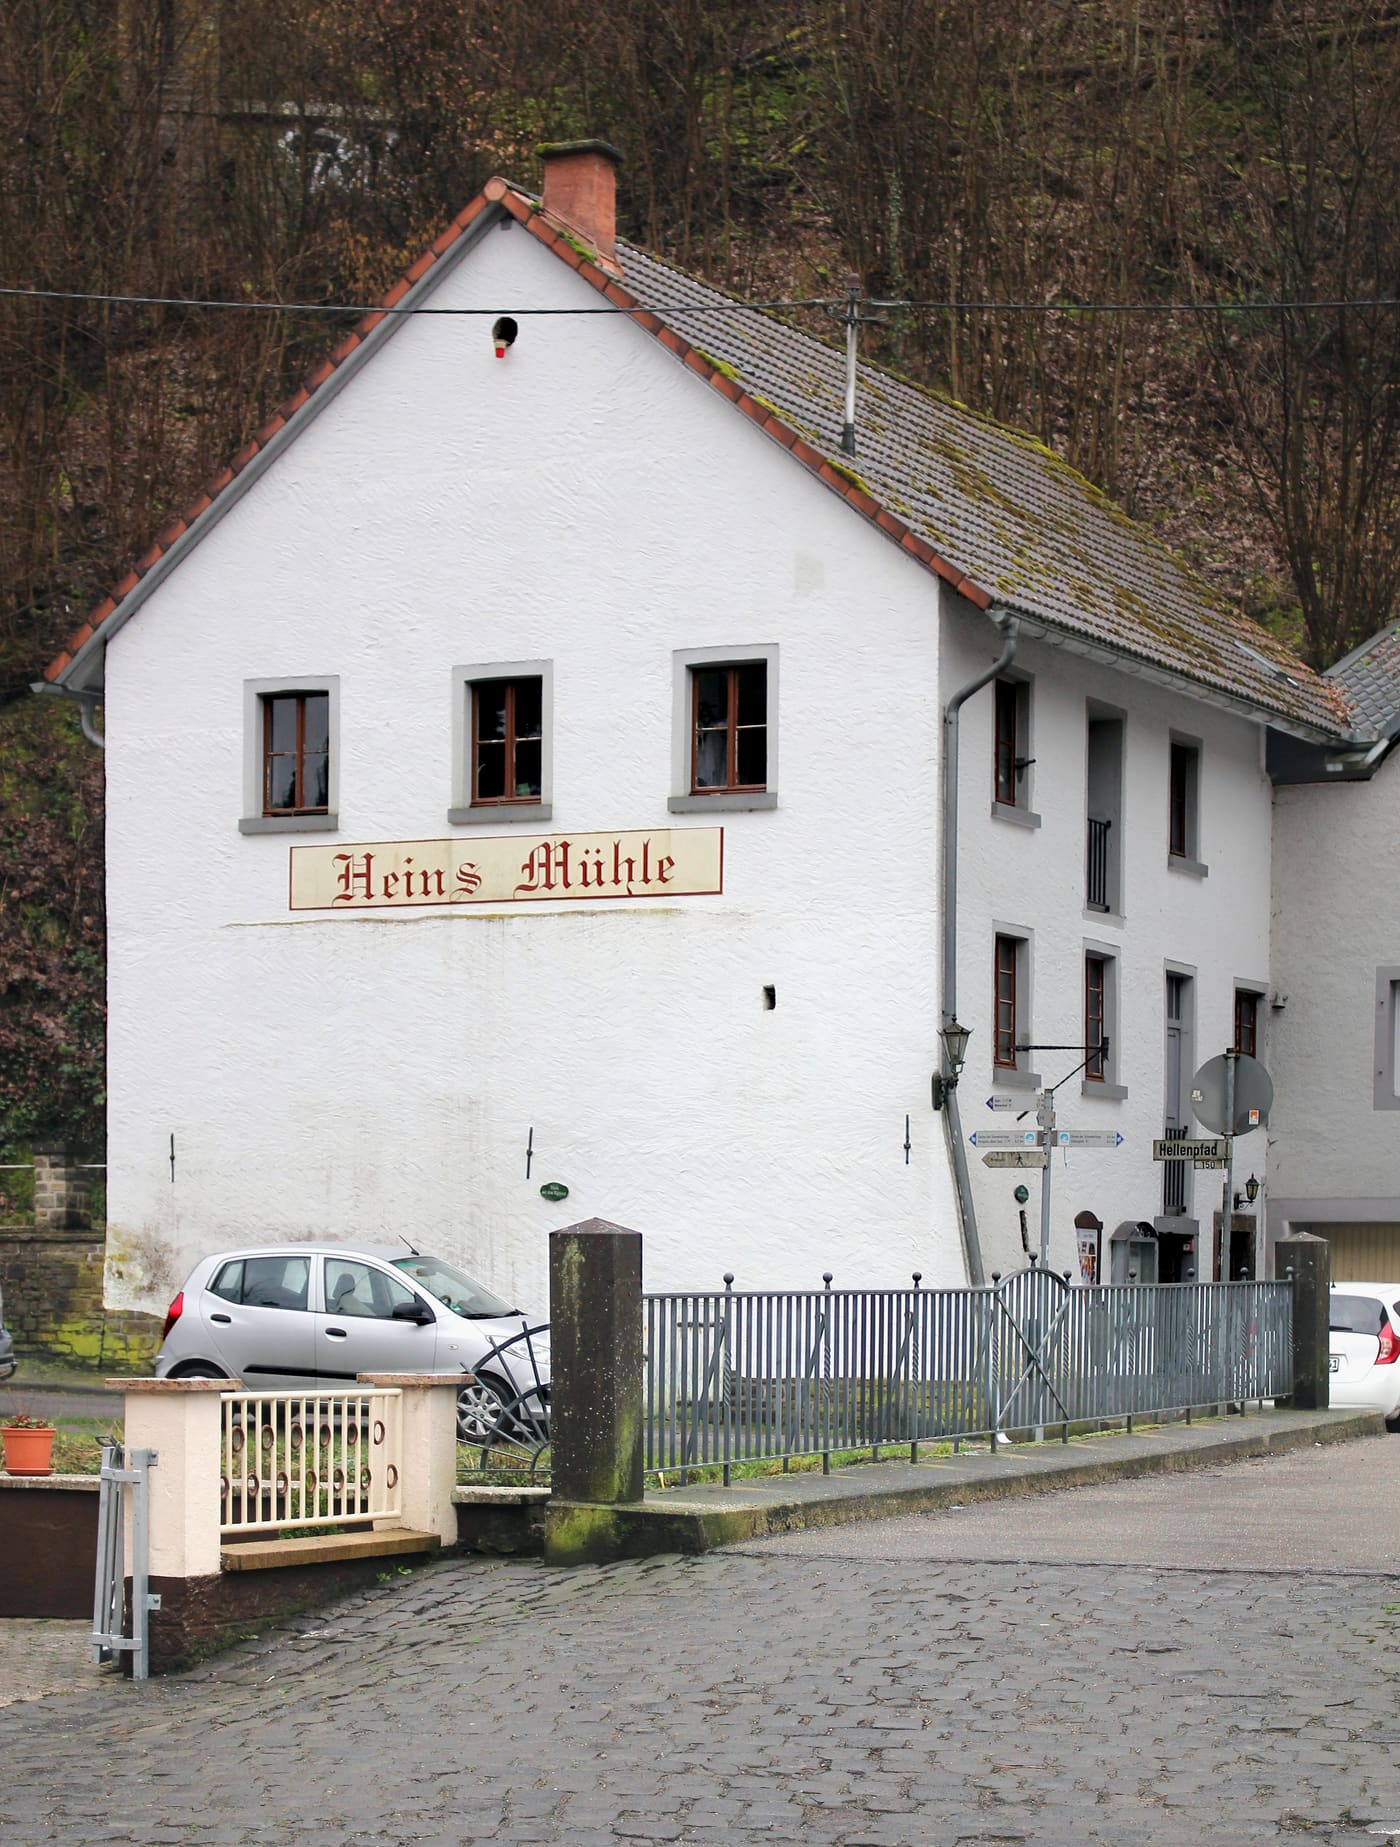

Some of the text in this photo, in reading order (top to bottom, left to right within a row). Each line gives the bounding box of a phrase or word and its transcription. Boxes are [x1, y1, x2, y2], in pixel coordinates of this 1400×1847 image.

[332, 838, 675, 907] Heins Mühle
[1159, 1143, 1217, 1159] Hellenpfad
